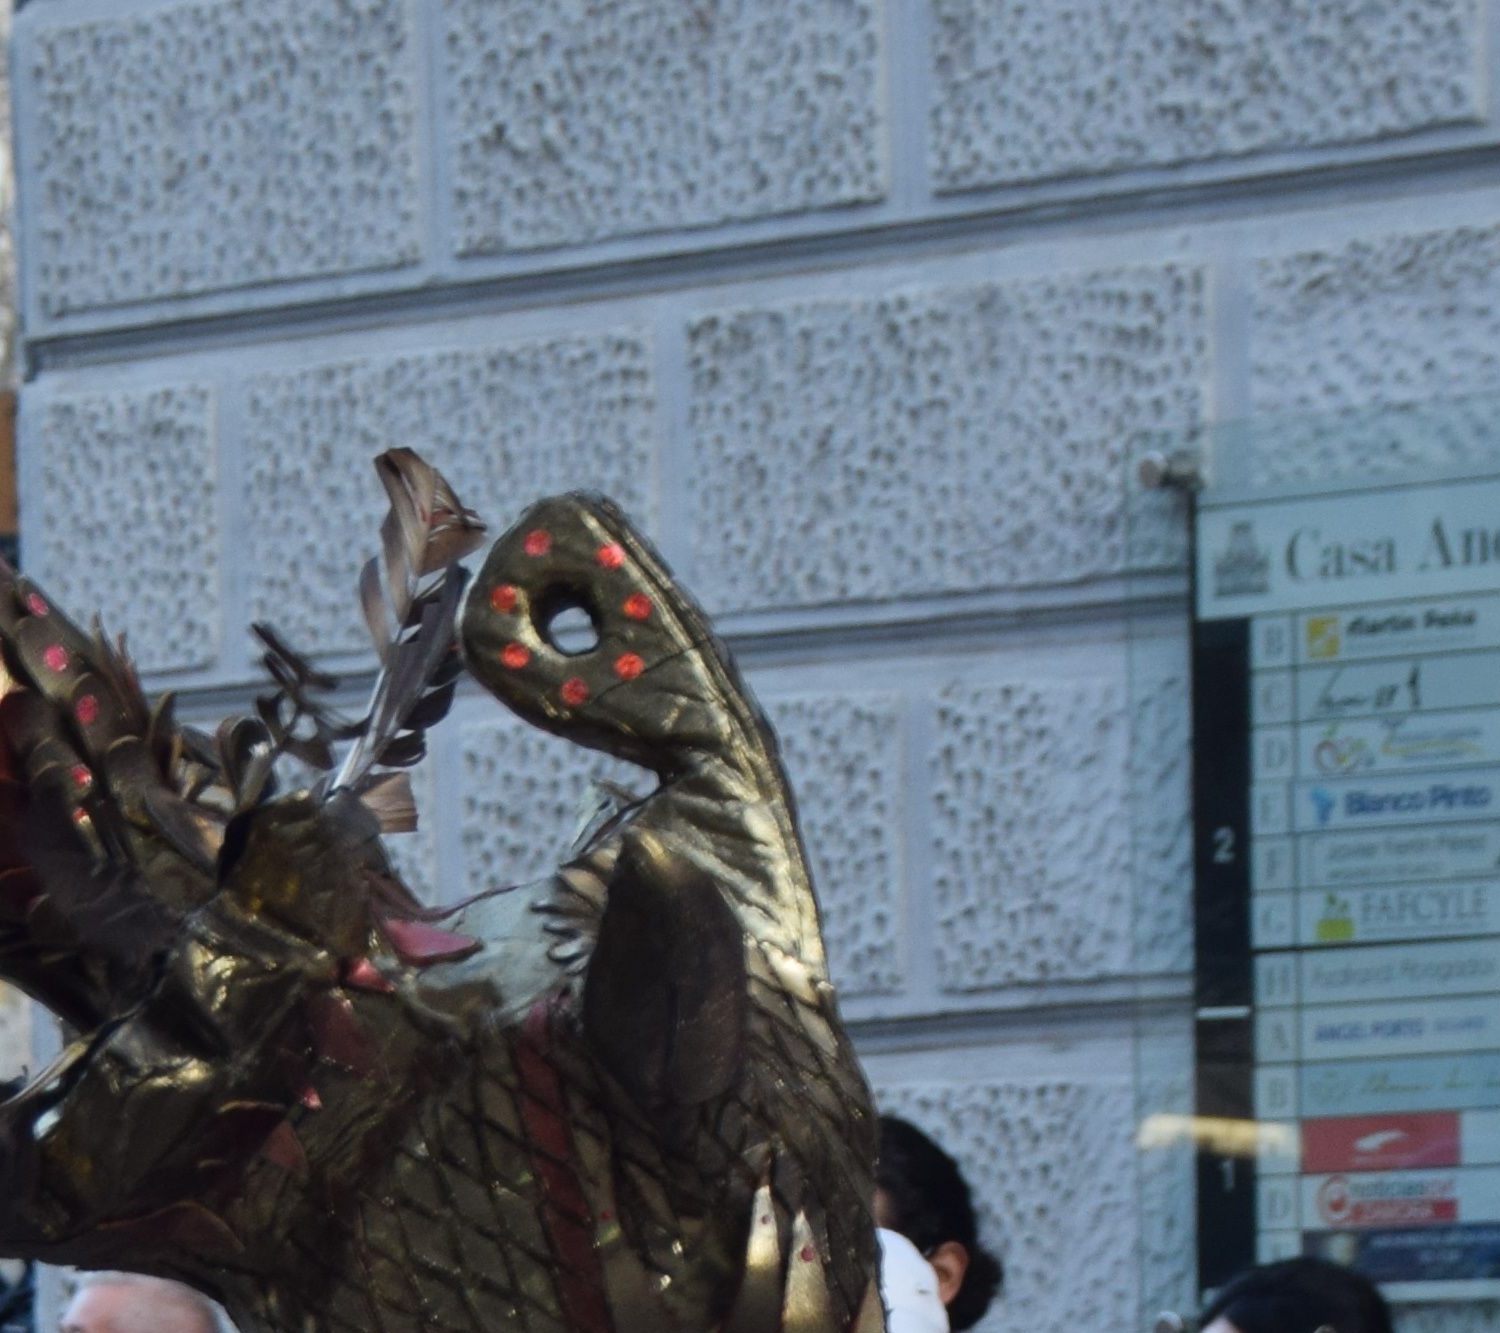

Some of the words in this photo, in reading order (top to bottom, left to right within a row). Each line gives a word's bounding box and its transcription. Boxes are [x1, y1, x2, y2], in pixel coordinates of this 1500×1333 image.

[1285, 526, 1397, 583] Casa
[1428, 783, 1491, 809] Pinto
[1212, 826, 1236, 864] 2
